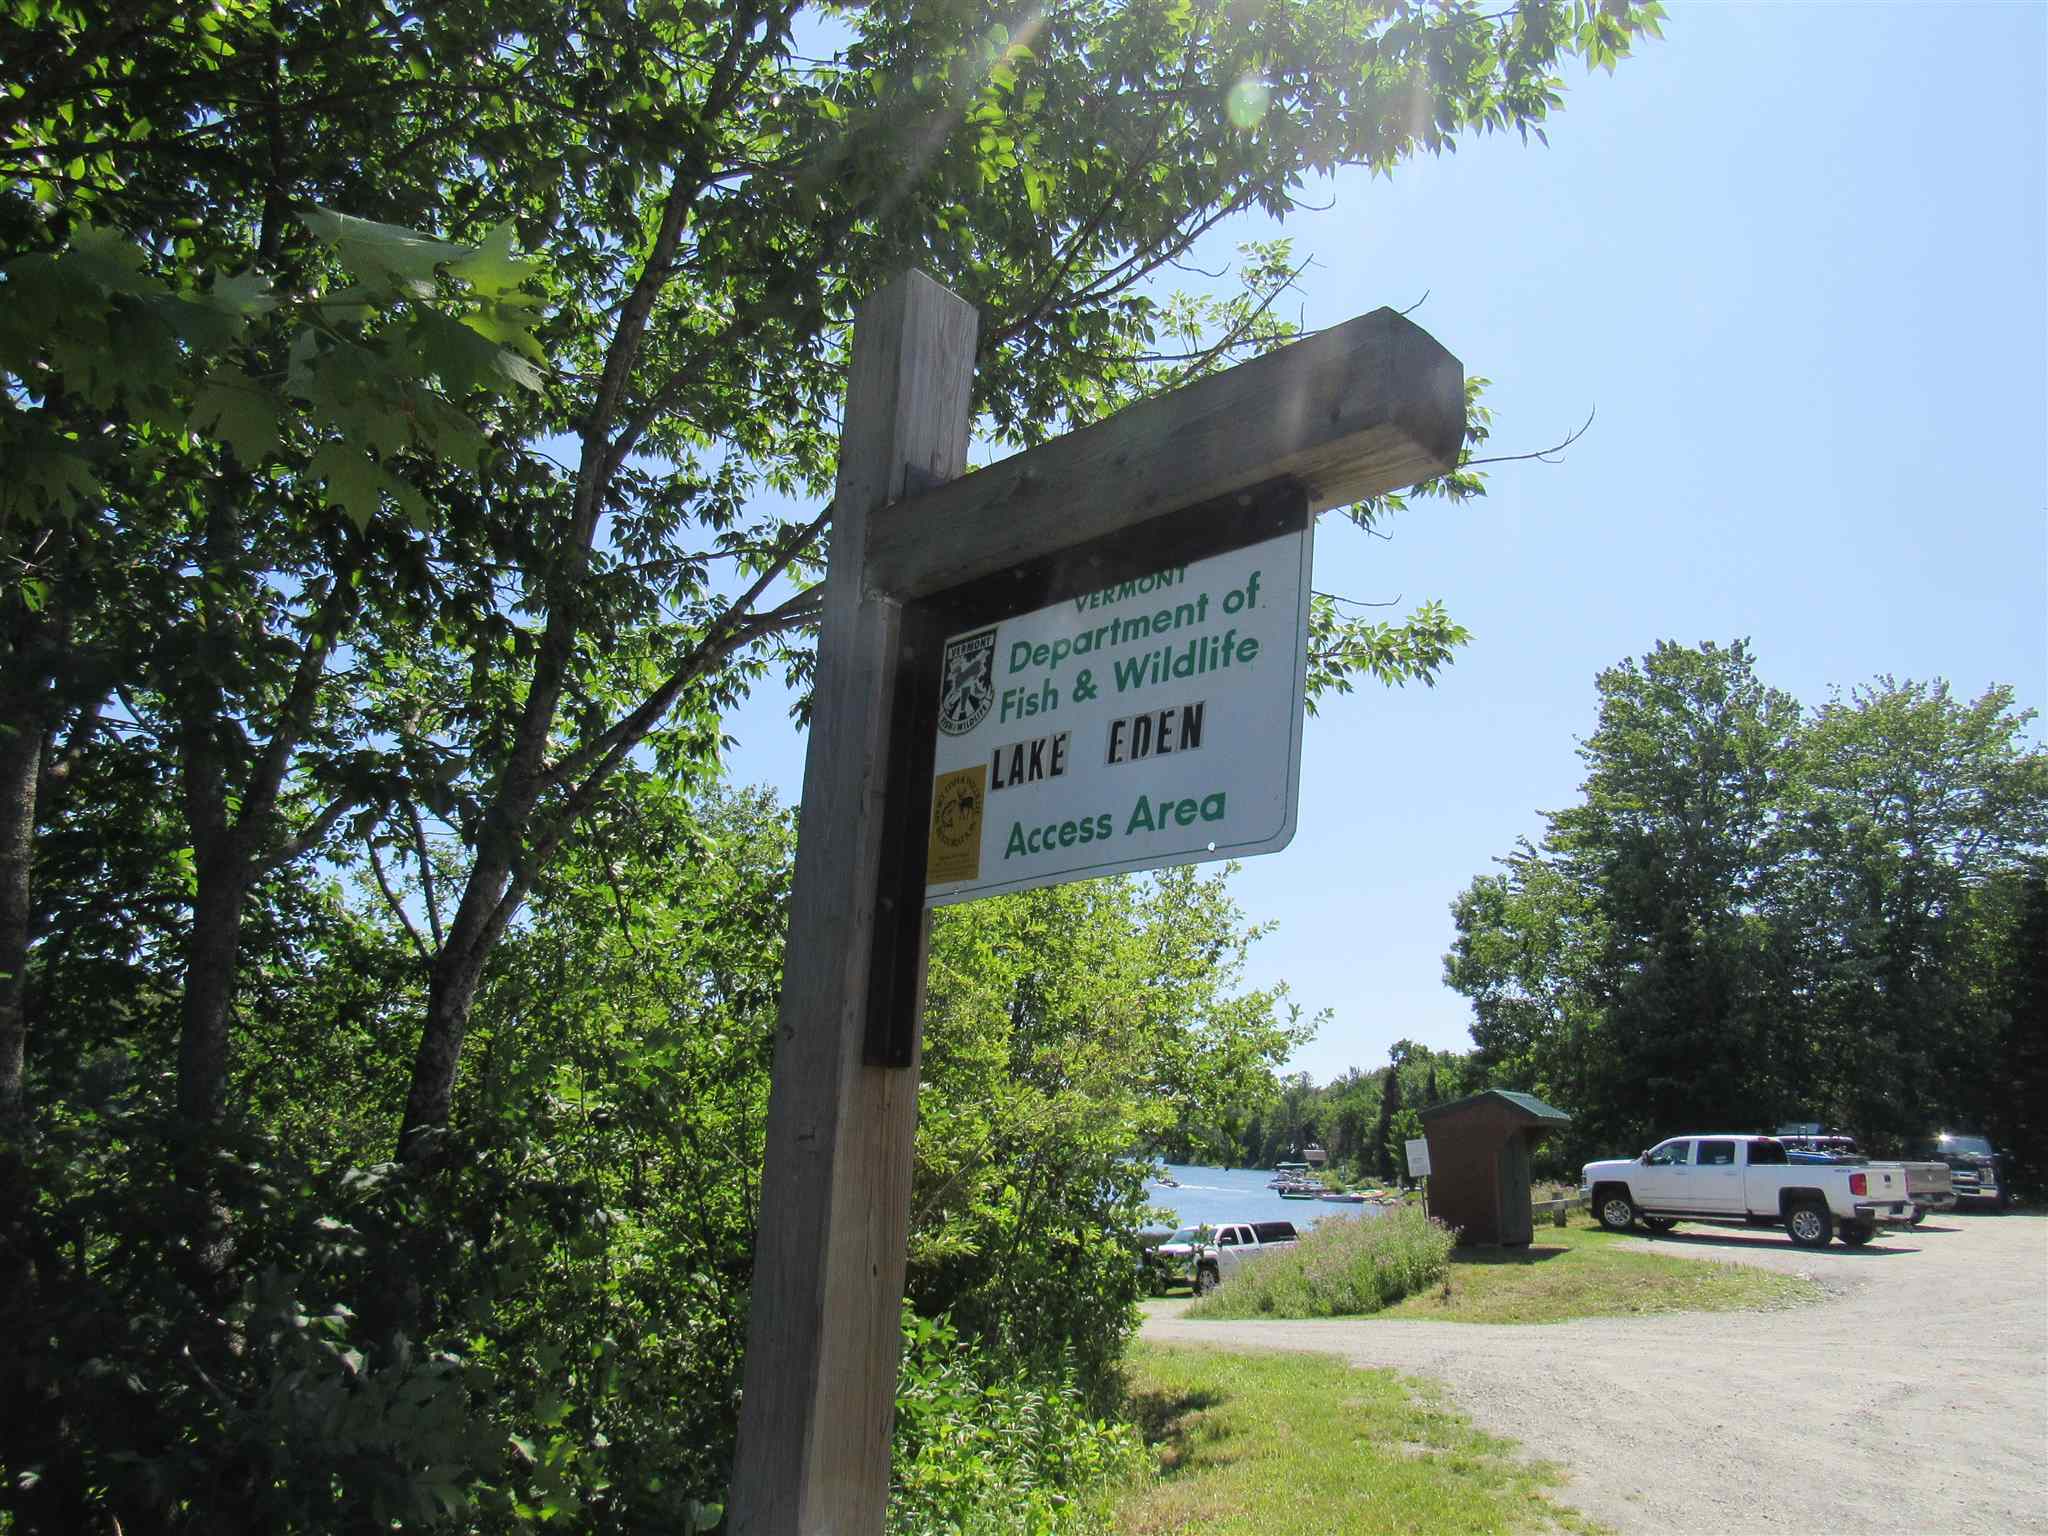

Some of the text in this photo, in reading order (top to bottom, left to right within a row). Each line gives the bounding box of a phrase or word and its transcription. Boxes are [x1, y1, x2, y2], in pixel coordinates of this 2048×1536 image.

[1009, 571, 1261, 674] Department of
[1074, 566, 1185, 613] VERMONT
[1000, 629, 1259, 723] Fish & Wildlife
[992, 702, 1204, 790] LAKE EDEN
[1004, 793, 1226, 859] Access Area
